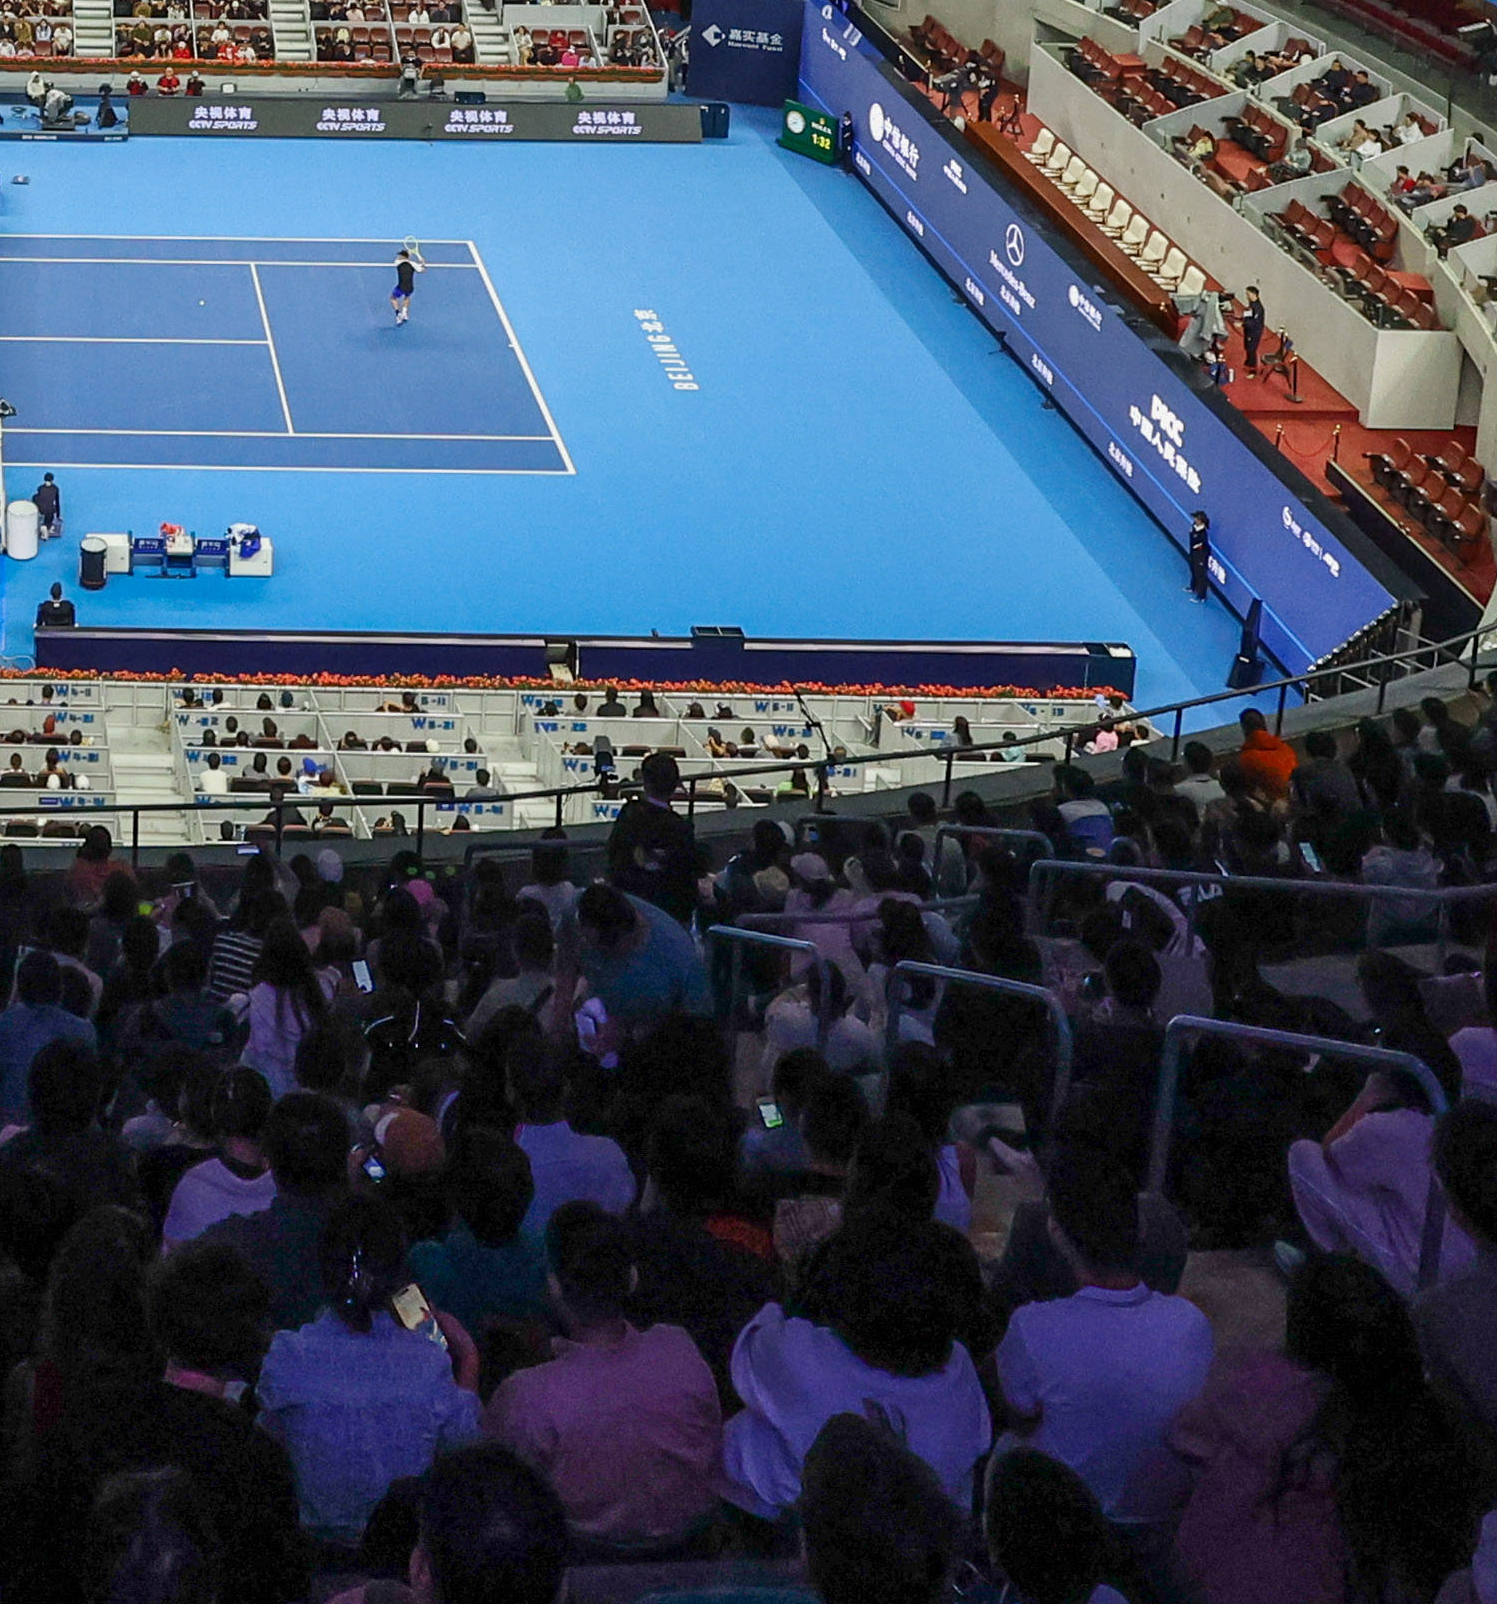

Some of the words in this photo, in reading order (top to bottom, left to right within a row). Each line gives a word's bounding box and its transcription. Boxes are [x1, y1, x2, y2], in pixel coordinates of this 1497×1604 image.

[728, 28, 784, 46] 嘉实基金
[194, 105, 252, 120] 央视体育
[321, 107, 380, 122] 央视体育
[449, 109, 508, 124] 央视体育
[577, 110, 636, 125] 央视体育
[188, 119, 214, 129] CCTV
[212, 120, 258, 130] SPORTS
[316, 121, 342, 131] CCTV
[340, 122, 387, 132] SPORTS
[443, 123, 469, 133] CCTV
[467, 123, 514, 134] SPORTS
[572, 124, 598, 135] CCTV
[596, 125, 643, 135] SPORTS
[812, 134, 831, 150] 1:32
[646, 333, 700, 391] BEIJING
[56, 686, 69, 696] W
[55, 712, 67, 722] W
[411, 718, 426, 729] W
